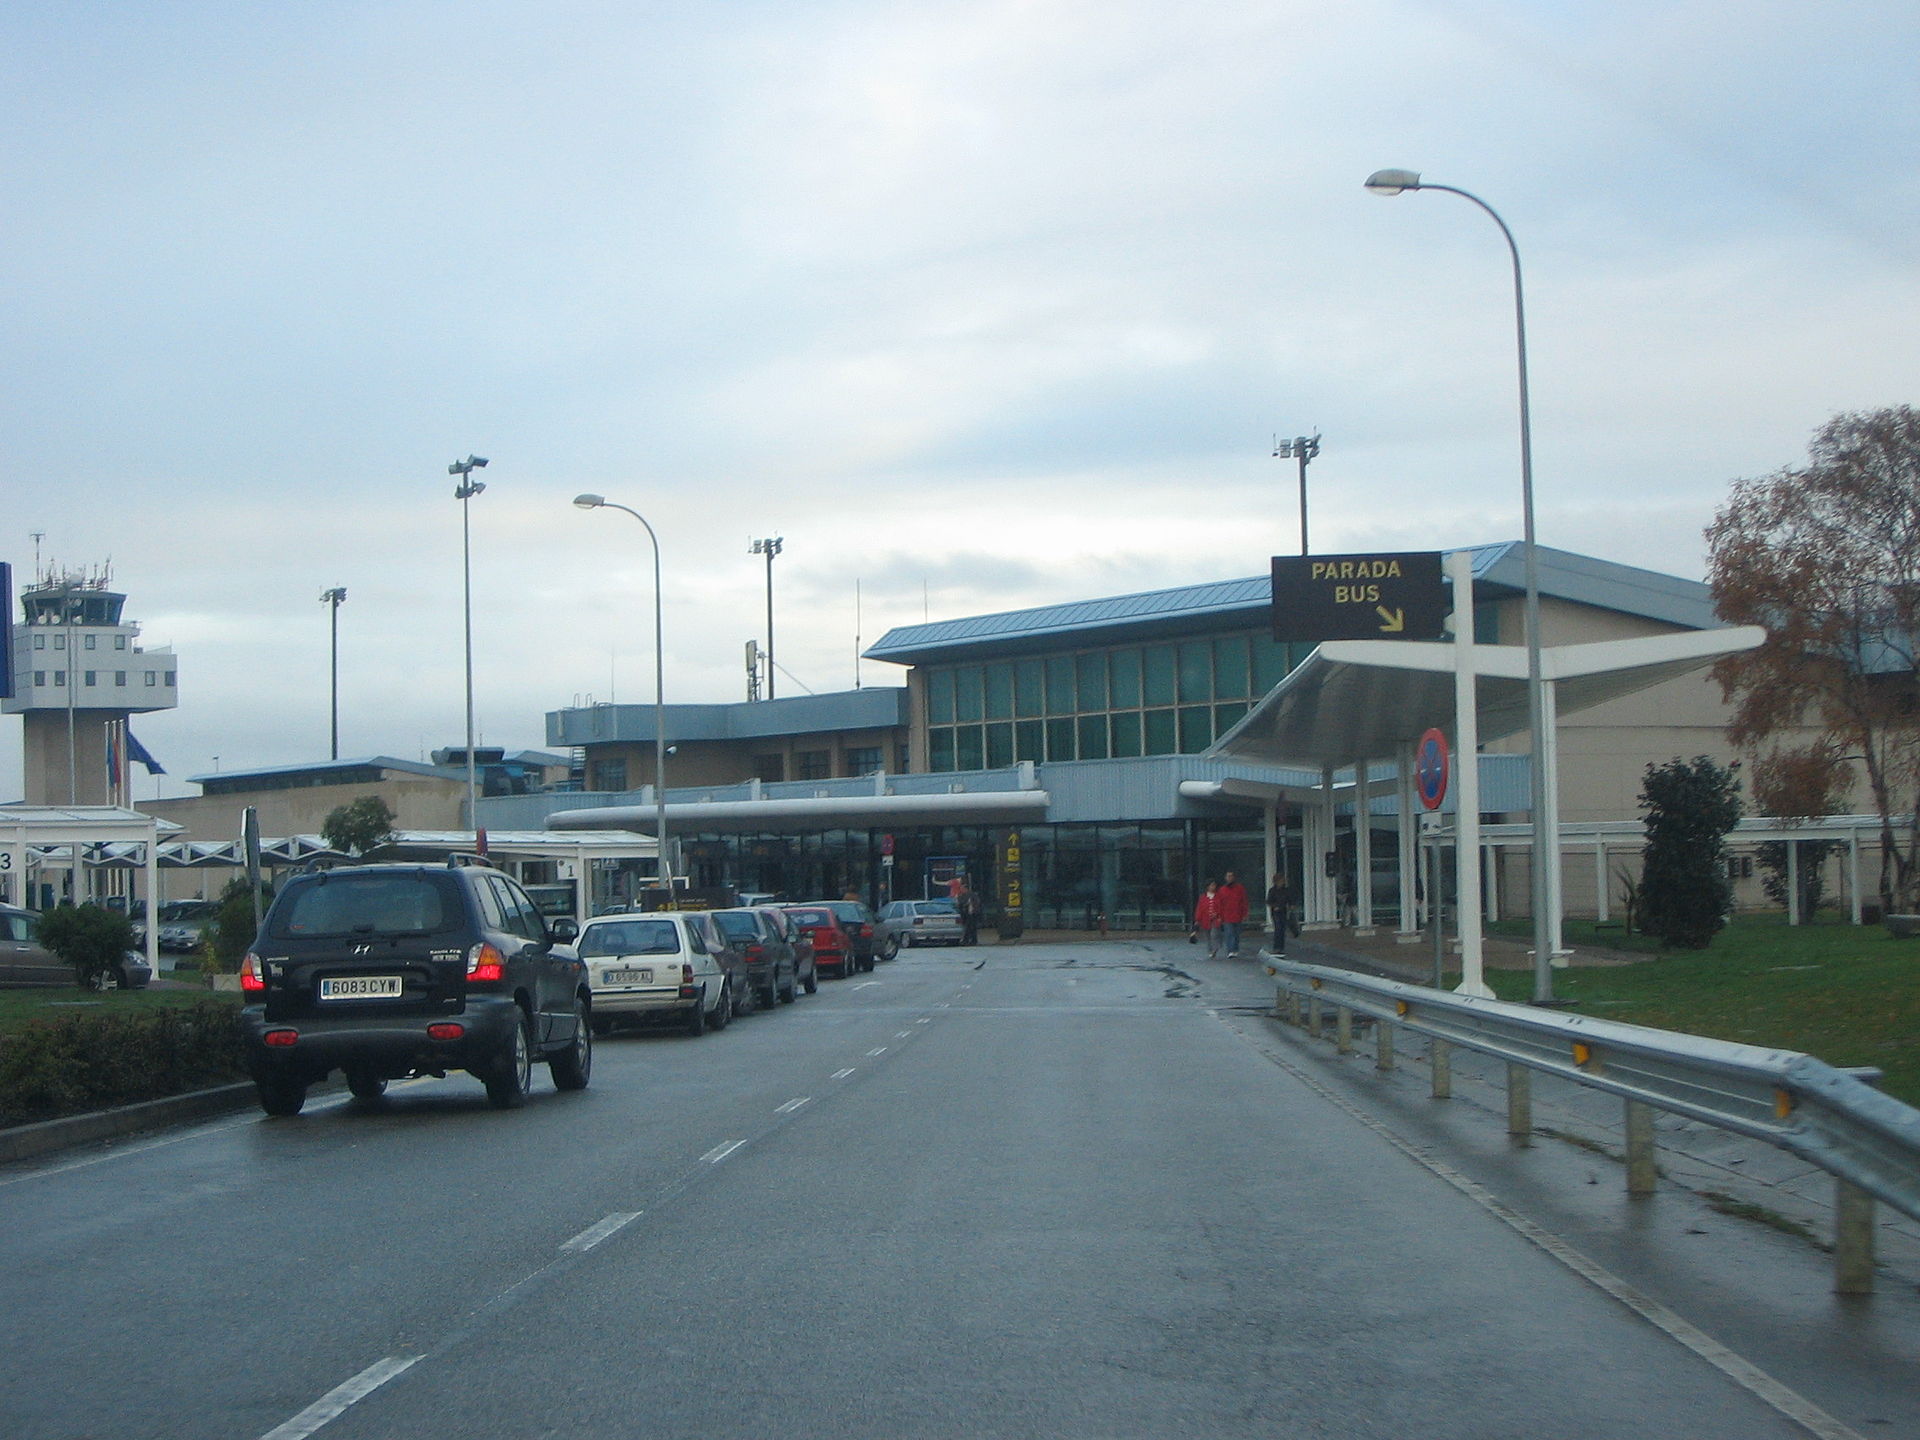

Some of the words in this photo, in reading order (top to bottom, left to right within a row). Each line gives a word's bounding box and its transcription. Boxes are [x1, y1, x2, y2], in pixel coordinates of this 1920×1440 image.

[1312, 560, 1401, 580] PARADA
[1335, 584, 1380, 603] BUS
[1, 852, 11, 870] 3
[567, 864, 574, 877] 1
[332, 981, 367, 993] 6083
